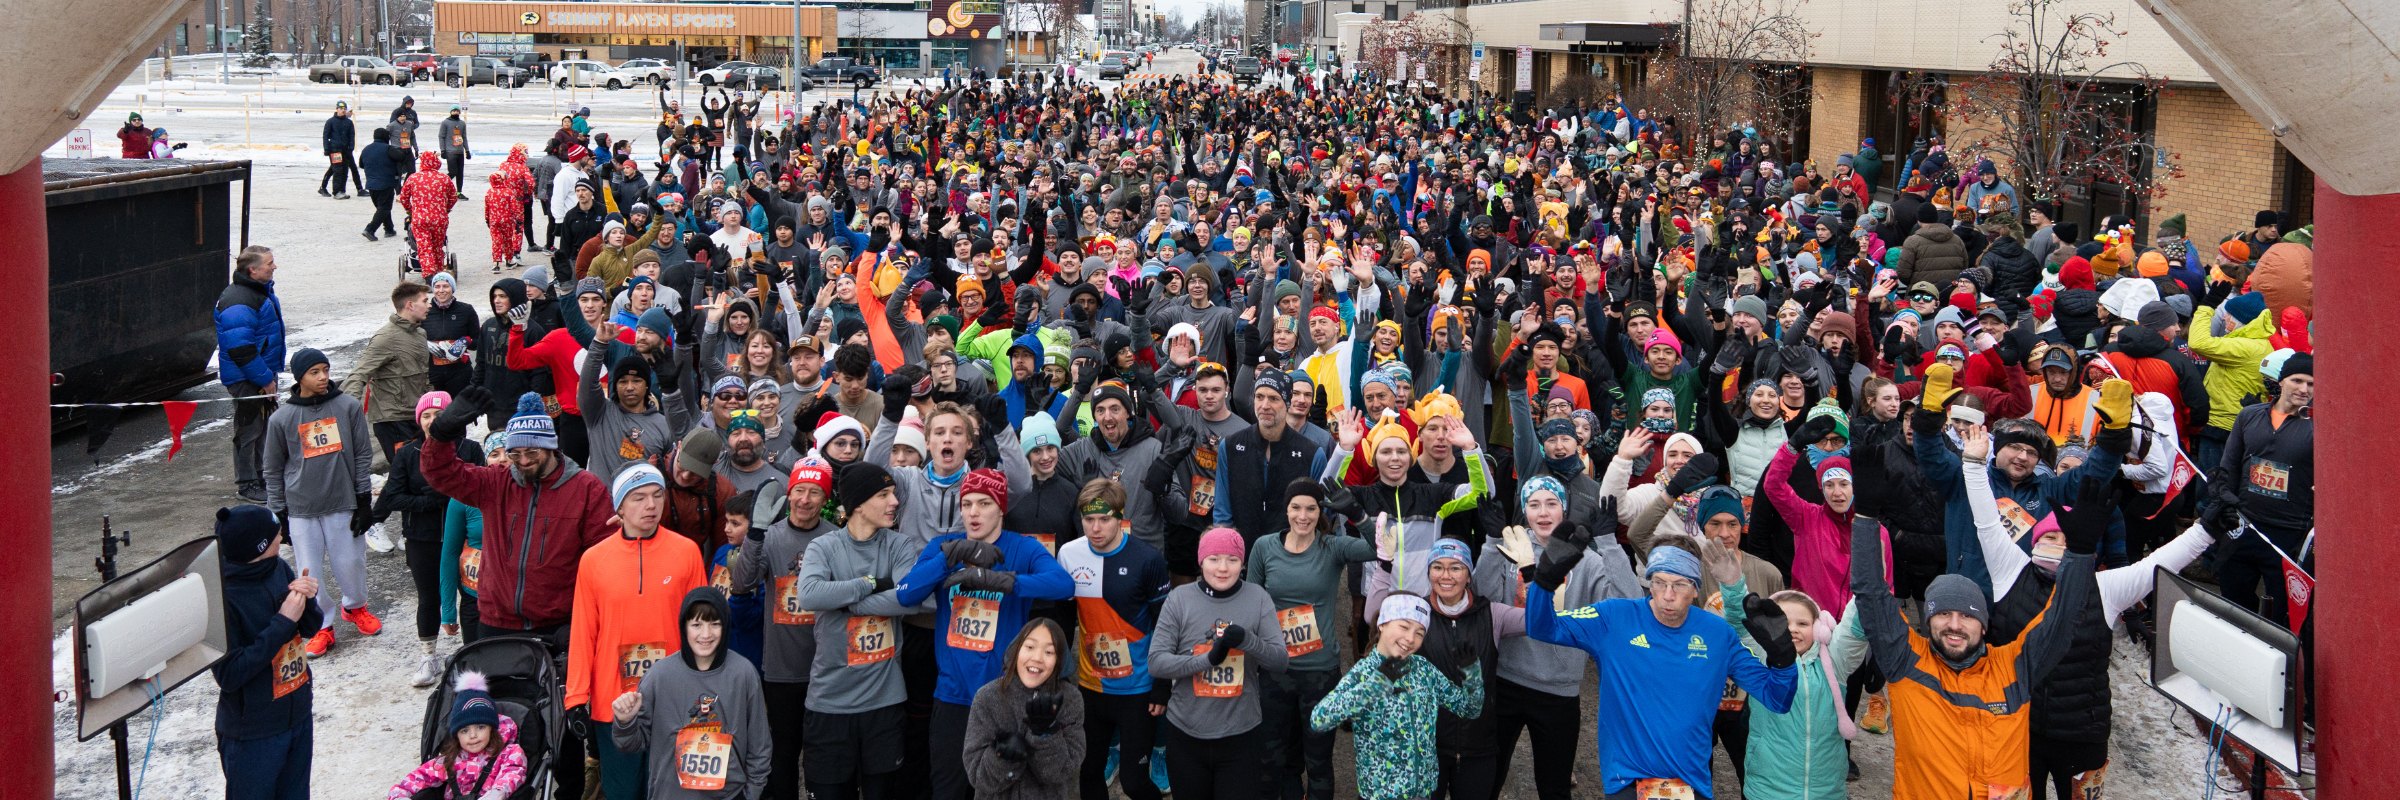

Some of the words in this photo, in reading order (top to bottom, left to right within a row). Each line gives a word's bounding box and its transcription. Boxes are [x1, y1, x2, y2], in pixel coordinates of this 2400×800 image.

[547, 12, 612, 26] SKINNY
[615, 13, 669, 27] RAVEN
[672, 13, 736, 28] SPORTS
[314, 433, 328, 446] 16
[1196, 449, 1218, 461] TURKE
[797, 470, 822, 480] AWS
[2251, 471, 2285, 490] 2574
[955, 616, 992, 638] 1837
[1281, 623, 1312, 645] 2107
[858, 632, 885, 652] 137
[624, 659, 661, 676] 179
[1096, 650, 1121, 667] 218
[281, 656, 304, 681] 298
[680, 753, 722, 776] 1550
